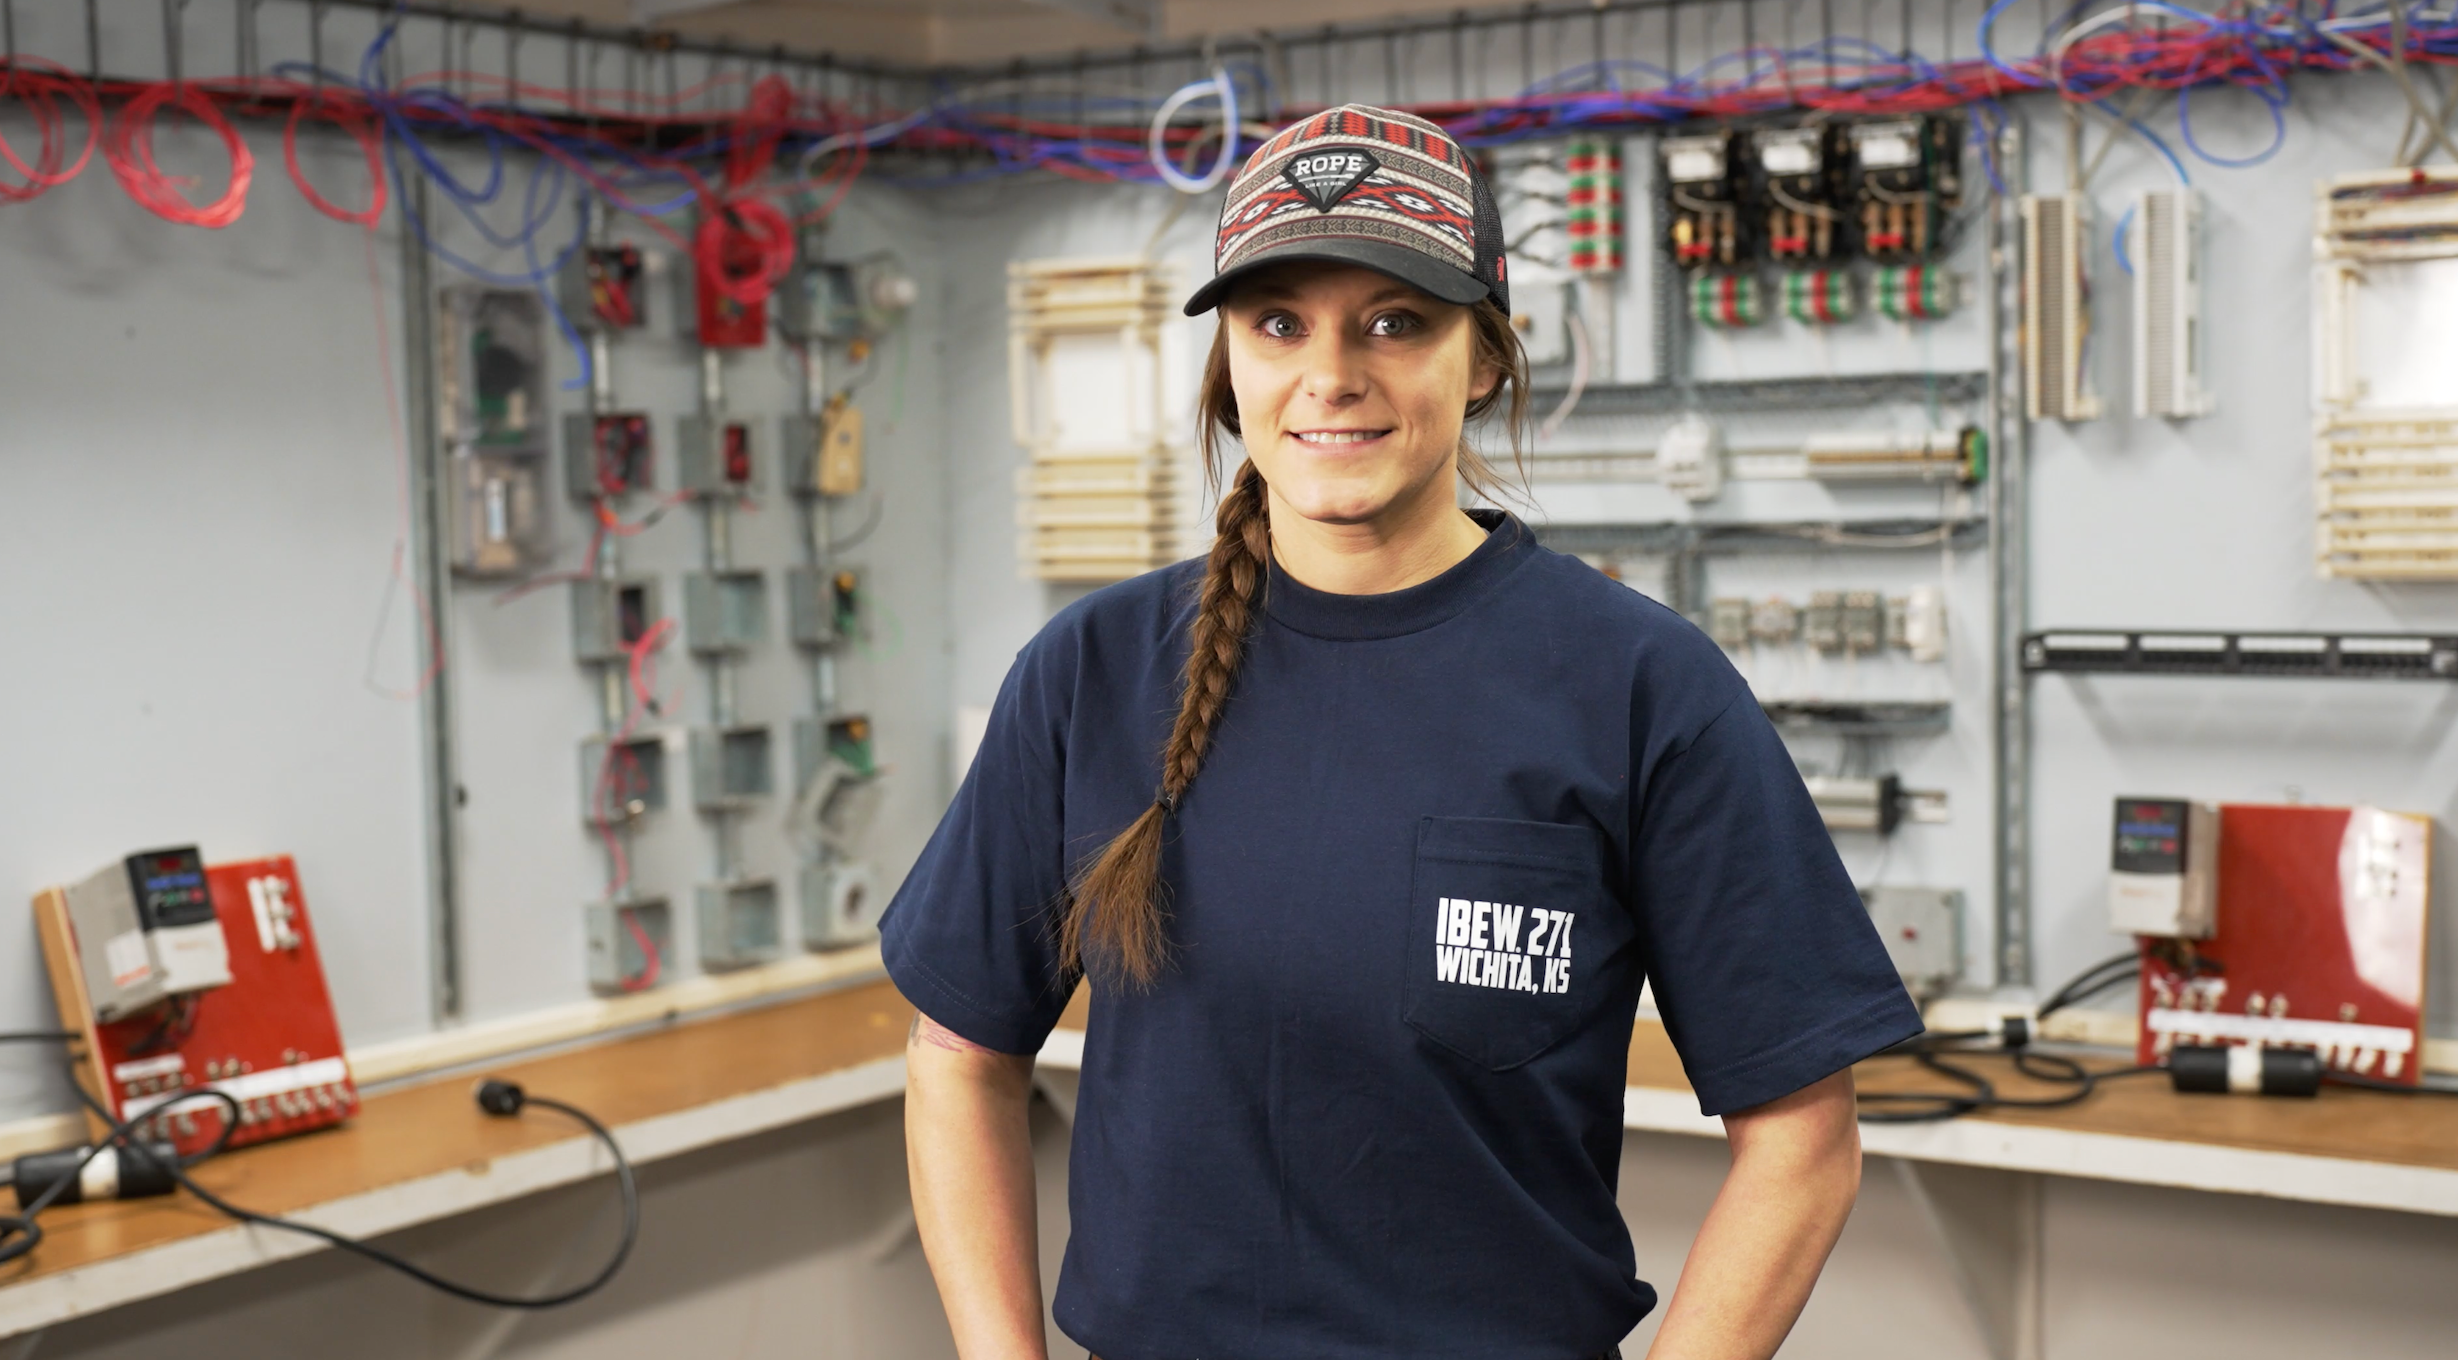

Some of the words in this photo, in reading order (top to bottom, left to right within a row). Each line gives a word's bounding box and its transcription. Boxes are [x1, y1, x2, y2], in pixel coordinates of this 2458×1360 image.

[1295, 155, 1362, 177] ROPE
[1527, 907, 1575, 958] 271
[1436, 944, 1539, 995] WICHITA,
[1543, 957, 1571, 994] KS
